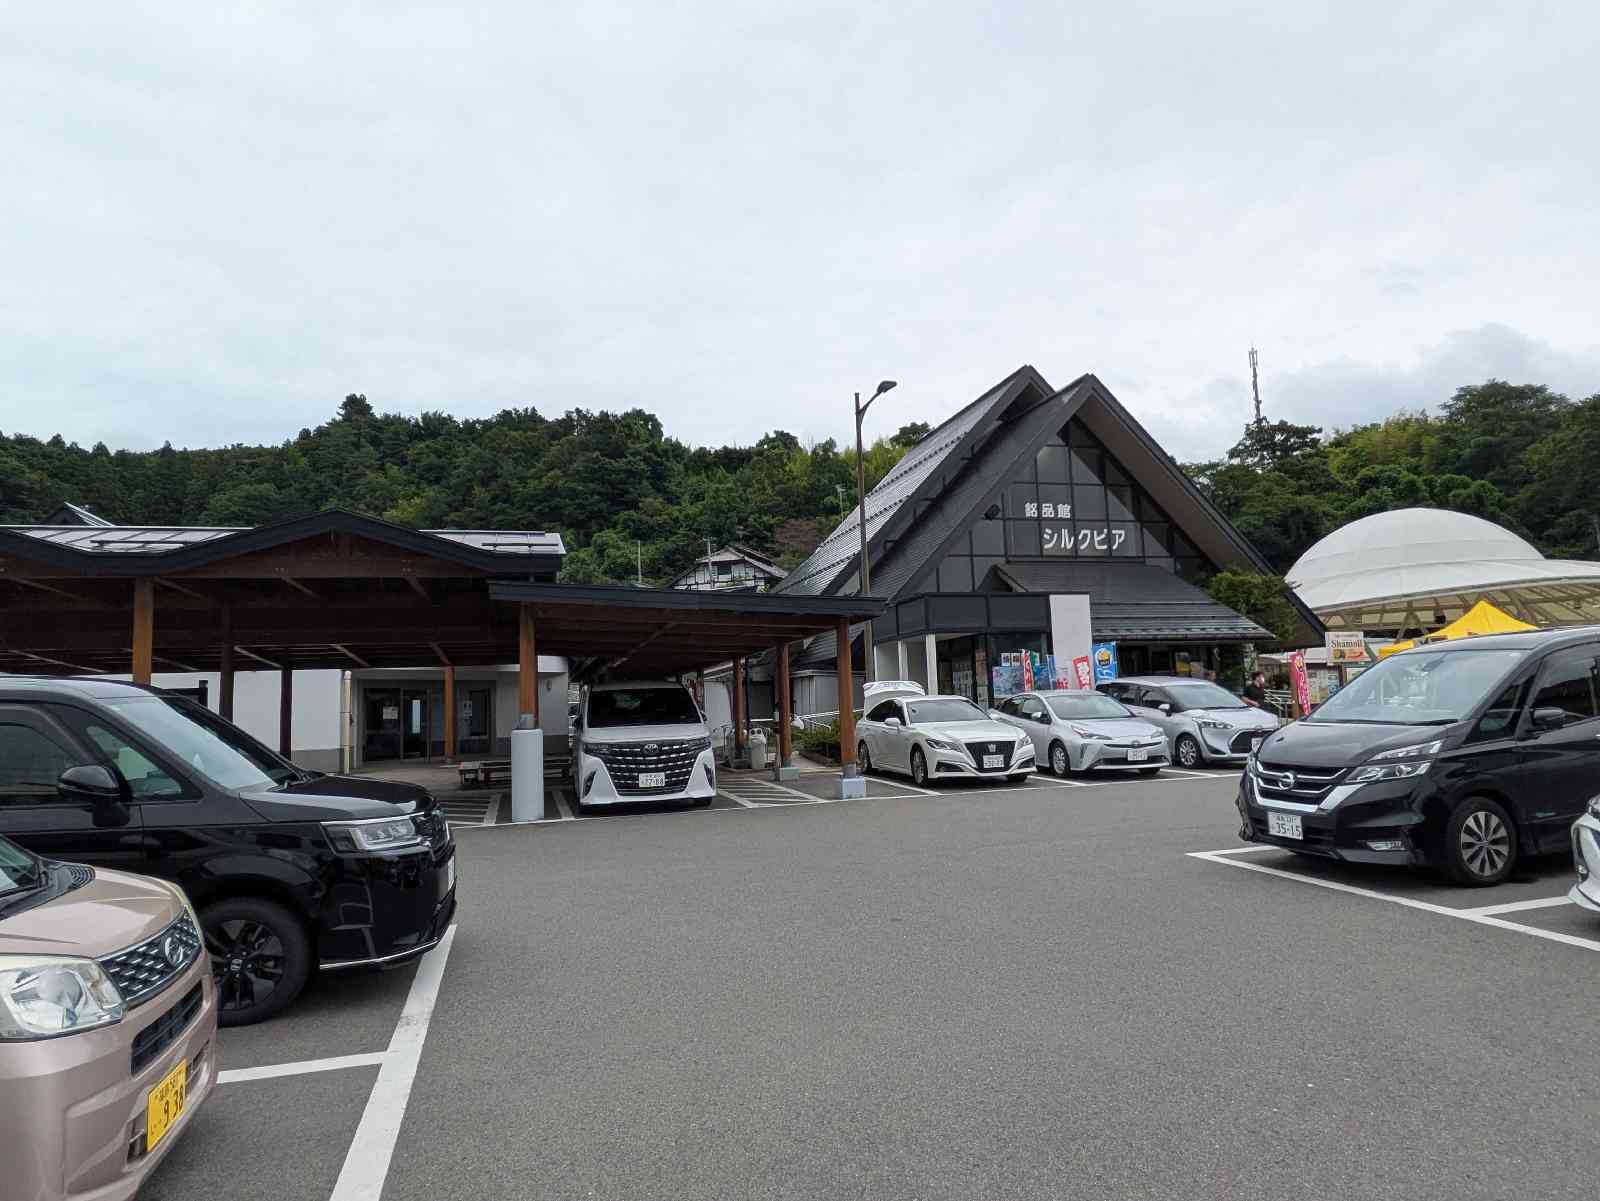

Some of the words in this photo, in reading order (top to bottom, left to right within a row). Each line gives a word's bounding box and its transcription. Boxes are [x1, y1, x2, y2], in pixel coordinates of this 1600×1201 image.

[1043, 528, 1126, 550] シルクピア
